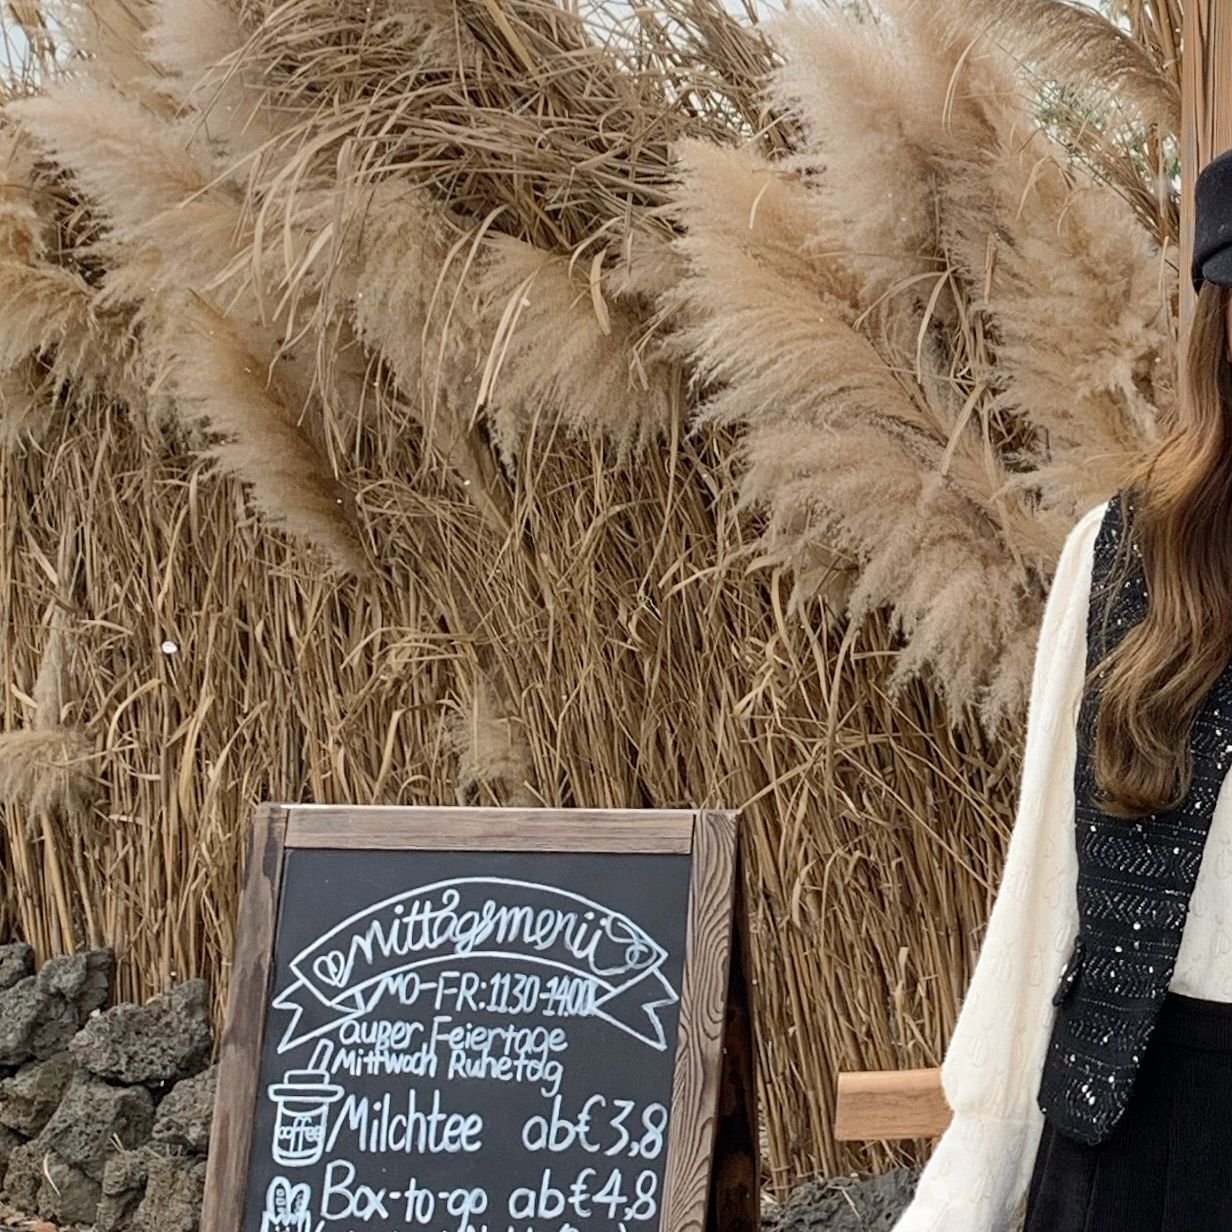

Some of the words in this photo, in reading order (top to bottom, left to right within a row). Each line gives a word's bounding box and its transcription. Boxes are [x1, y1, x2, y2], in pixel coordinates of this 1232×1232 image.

[341, 889, 612, 987] Mittagsmenü
[339, 1018, 424, 1052] außer
[430, 1016, 569, 1063] Feiertage
[333, 1043, 438, 1079] Mittwoch
[448, 1049, 564, 1097] Ruhetag
[325, 1088, 483, 1154] Milchtee
